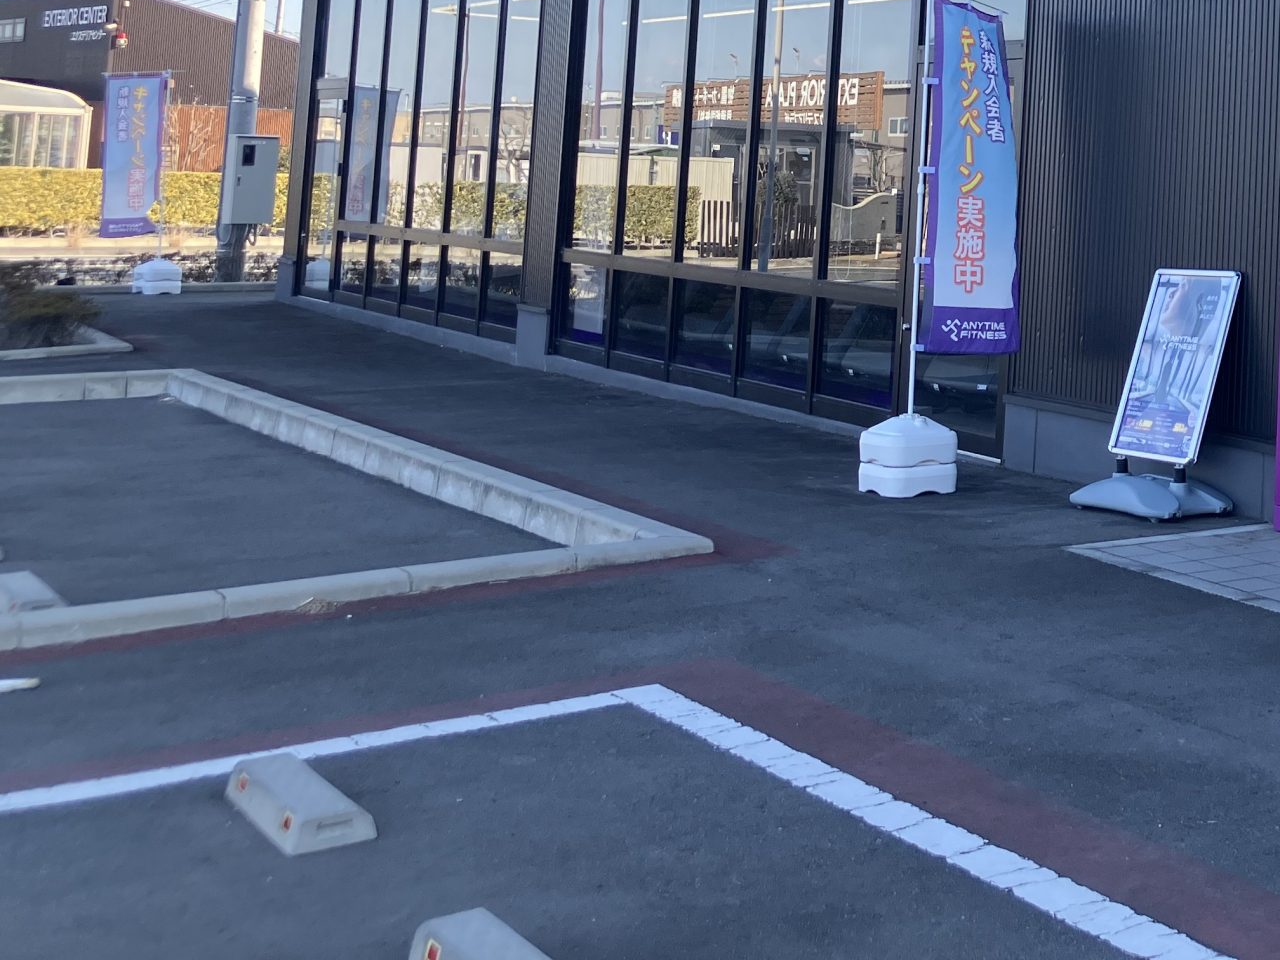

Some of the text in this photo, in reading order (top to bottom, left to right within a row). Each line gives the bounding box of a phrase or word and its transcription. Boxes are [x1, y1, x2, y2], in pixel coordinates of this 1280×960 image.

[43, 5, 108, 28] EXTERIOR CENTER
[978, 29, 1006, 143] 新規入会者
[954, 26, 985, 294] キャンペーン実施中
[960, 330, 1007, 340] FITNESS
